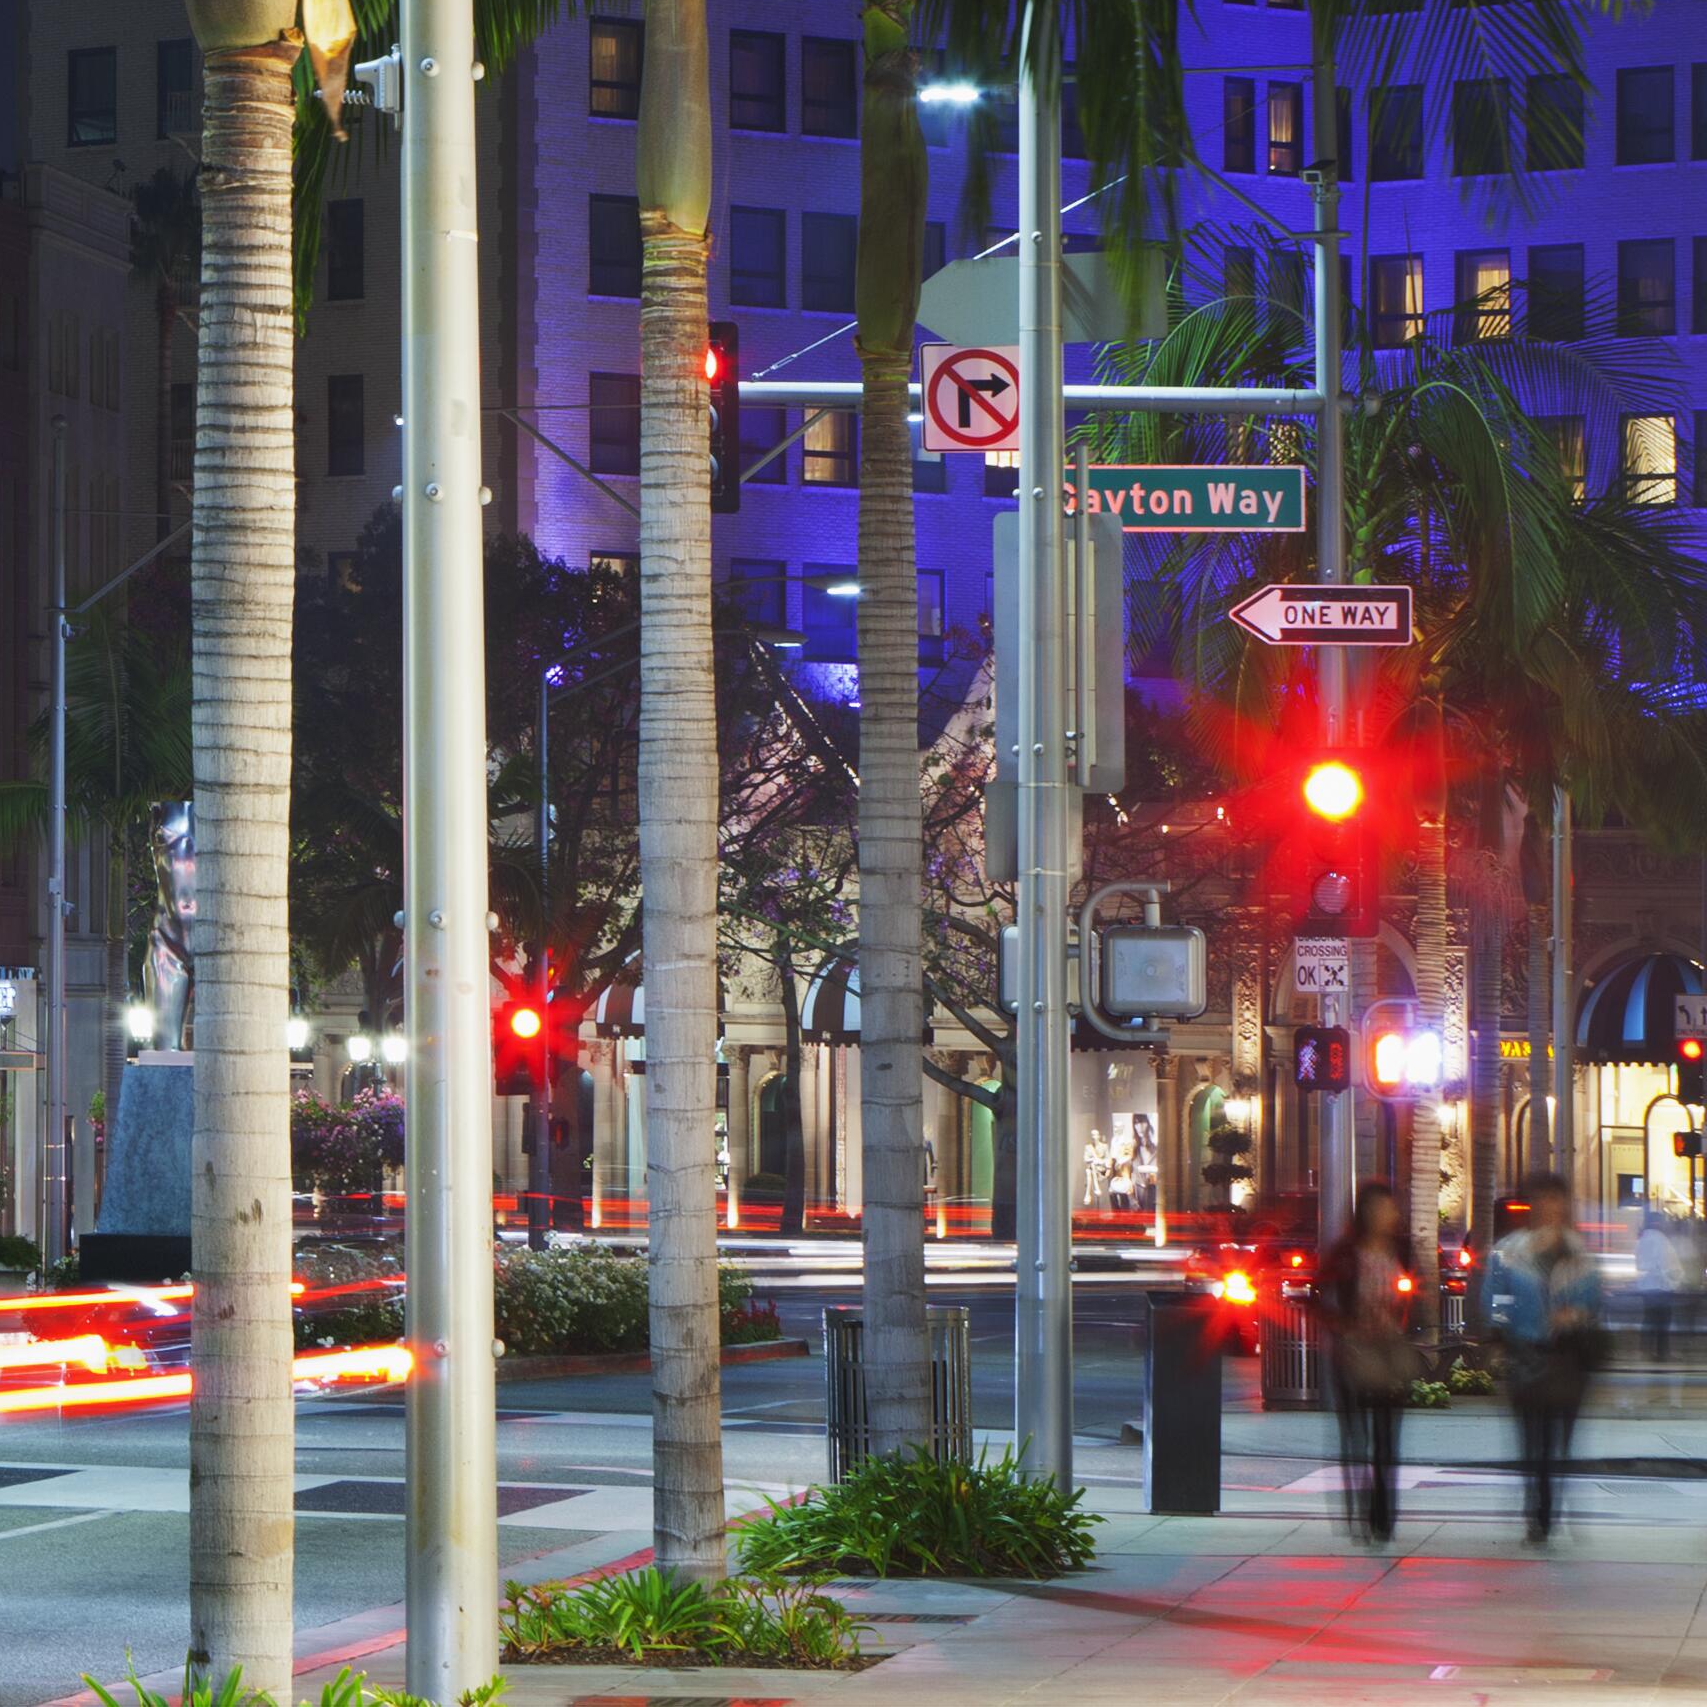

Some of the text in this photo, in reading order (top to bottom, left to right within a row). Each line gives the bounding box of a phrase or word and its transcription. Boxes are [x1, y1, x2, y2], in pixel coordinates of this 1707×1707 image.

[1207, 482, 1284, 523] Way
[1284, 605, 1389, 625] ONE WAY
[1297, 945, 1347, 957] CROSSING
[1298, 965, 1317, 986] OK
